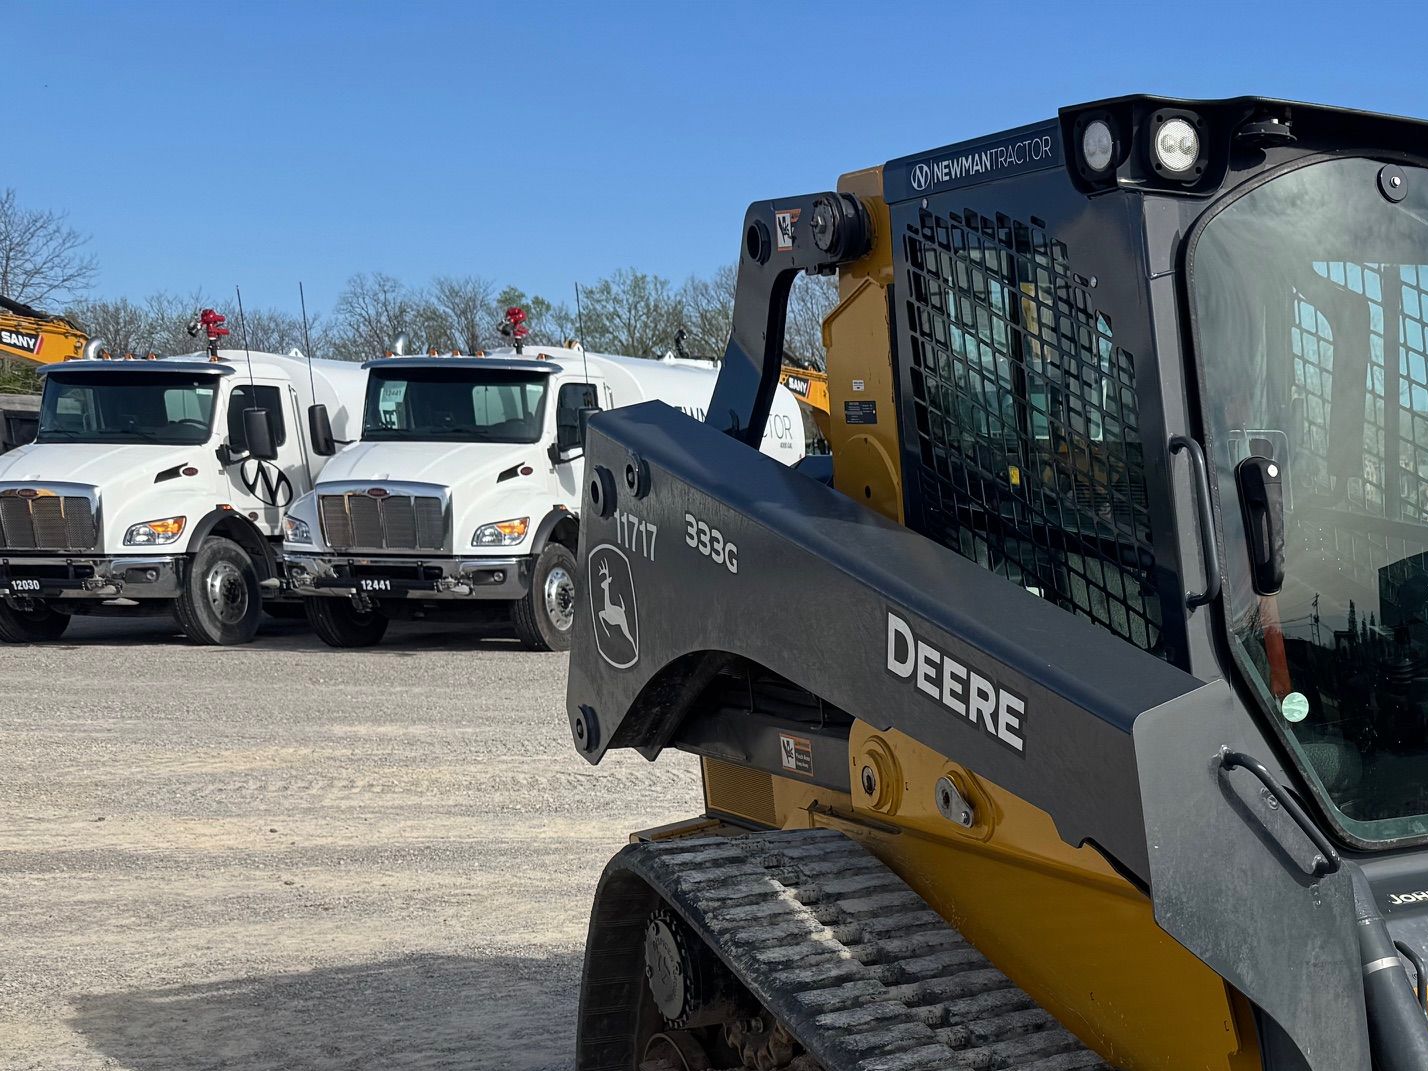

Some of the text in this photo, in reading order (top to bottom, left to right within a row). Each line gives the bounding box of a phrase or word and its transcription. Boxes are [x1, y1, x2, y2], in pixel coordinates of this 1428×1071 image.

[1, 331, 36, 349] SANY
[788, 377, 808, 394] SANY
[613, 508, 658, 562] 11717
[685, 513, 738, 574] 333G
[11, 579, 40, 590] 12030
[360, 579, 391, 590] 12441
[887, 612, 1025, 751] DEERE
